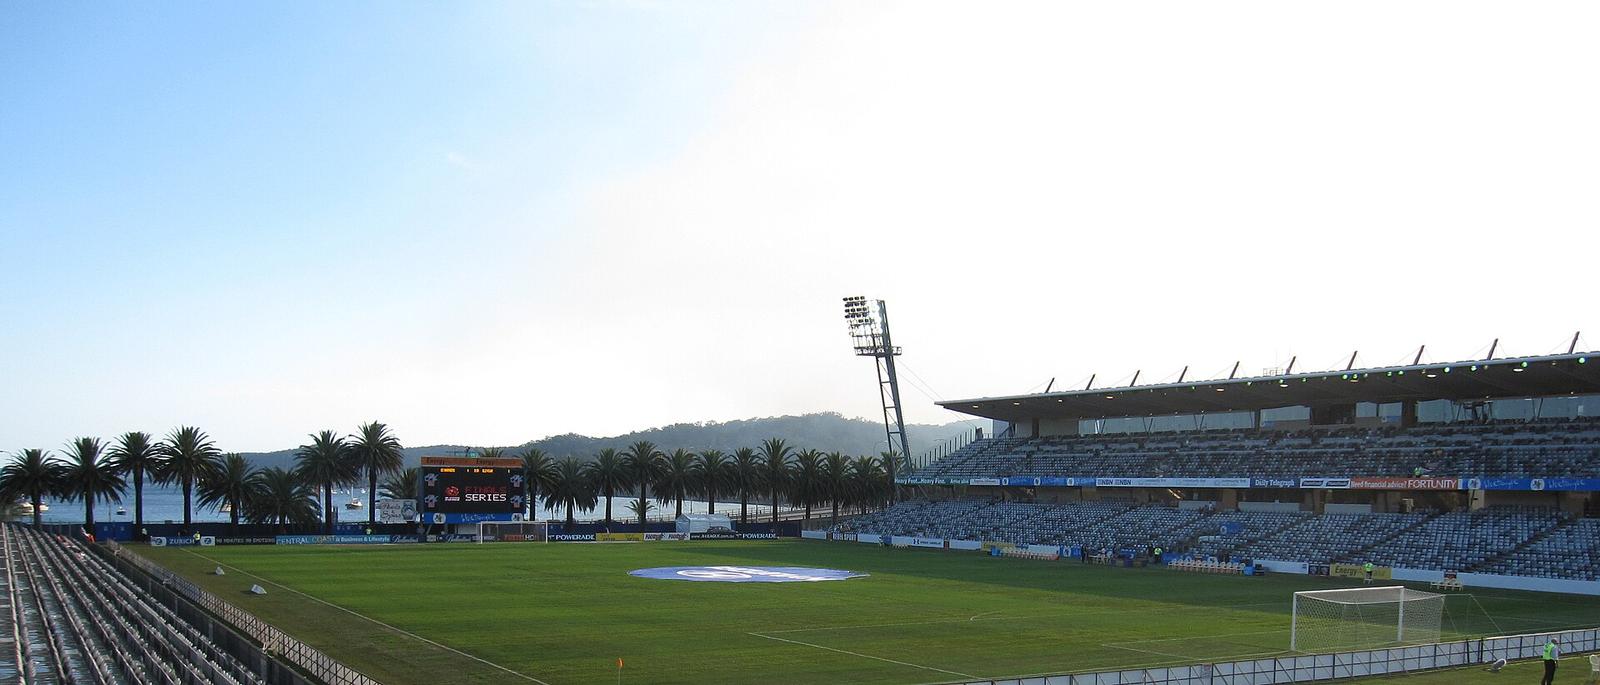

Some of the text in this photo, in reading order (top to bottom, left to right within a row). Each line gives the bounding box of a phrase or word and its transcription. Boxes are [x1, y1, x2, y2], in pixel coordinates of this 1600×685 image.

[1255, 479, 1269, 487] Daily
[1269, 479, 1295, 488] Telegraph
[1351, 480, 1364, 488] Need
[1364, 480, 1387, 488] financial
[1387, 480, 1407, 488] advice?
[1407, 479, 1457, 489] FORTUNITY
[465, 493, 507, 502] SERIES
[276, 535, 336, 545] CENTRAL COAST
[1335, 565, 1357, 576] Energy
